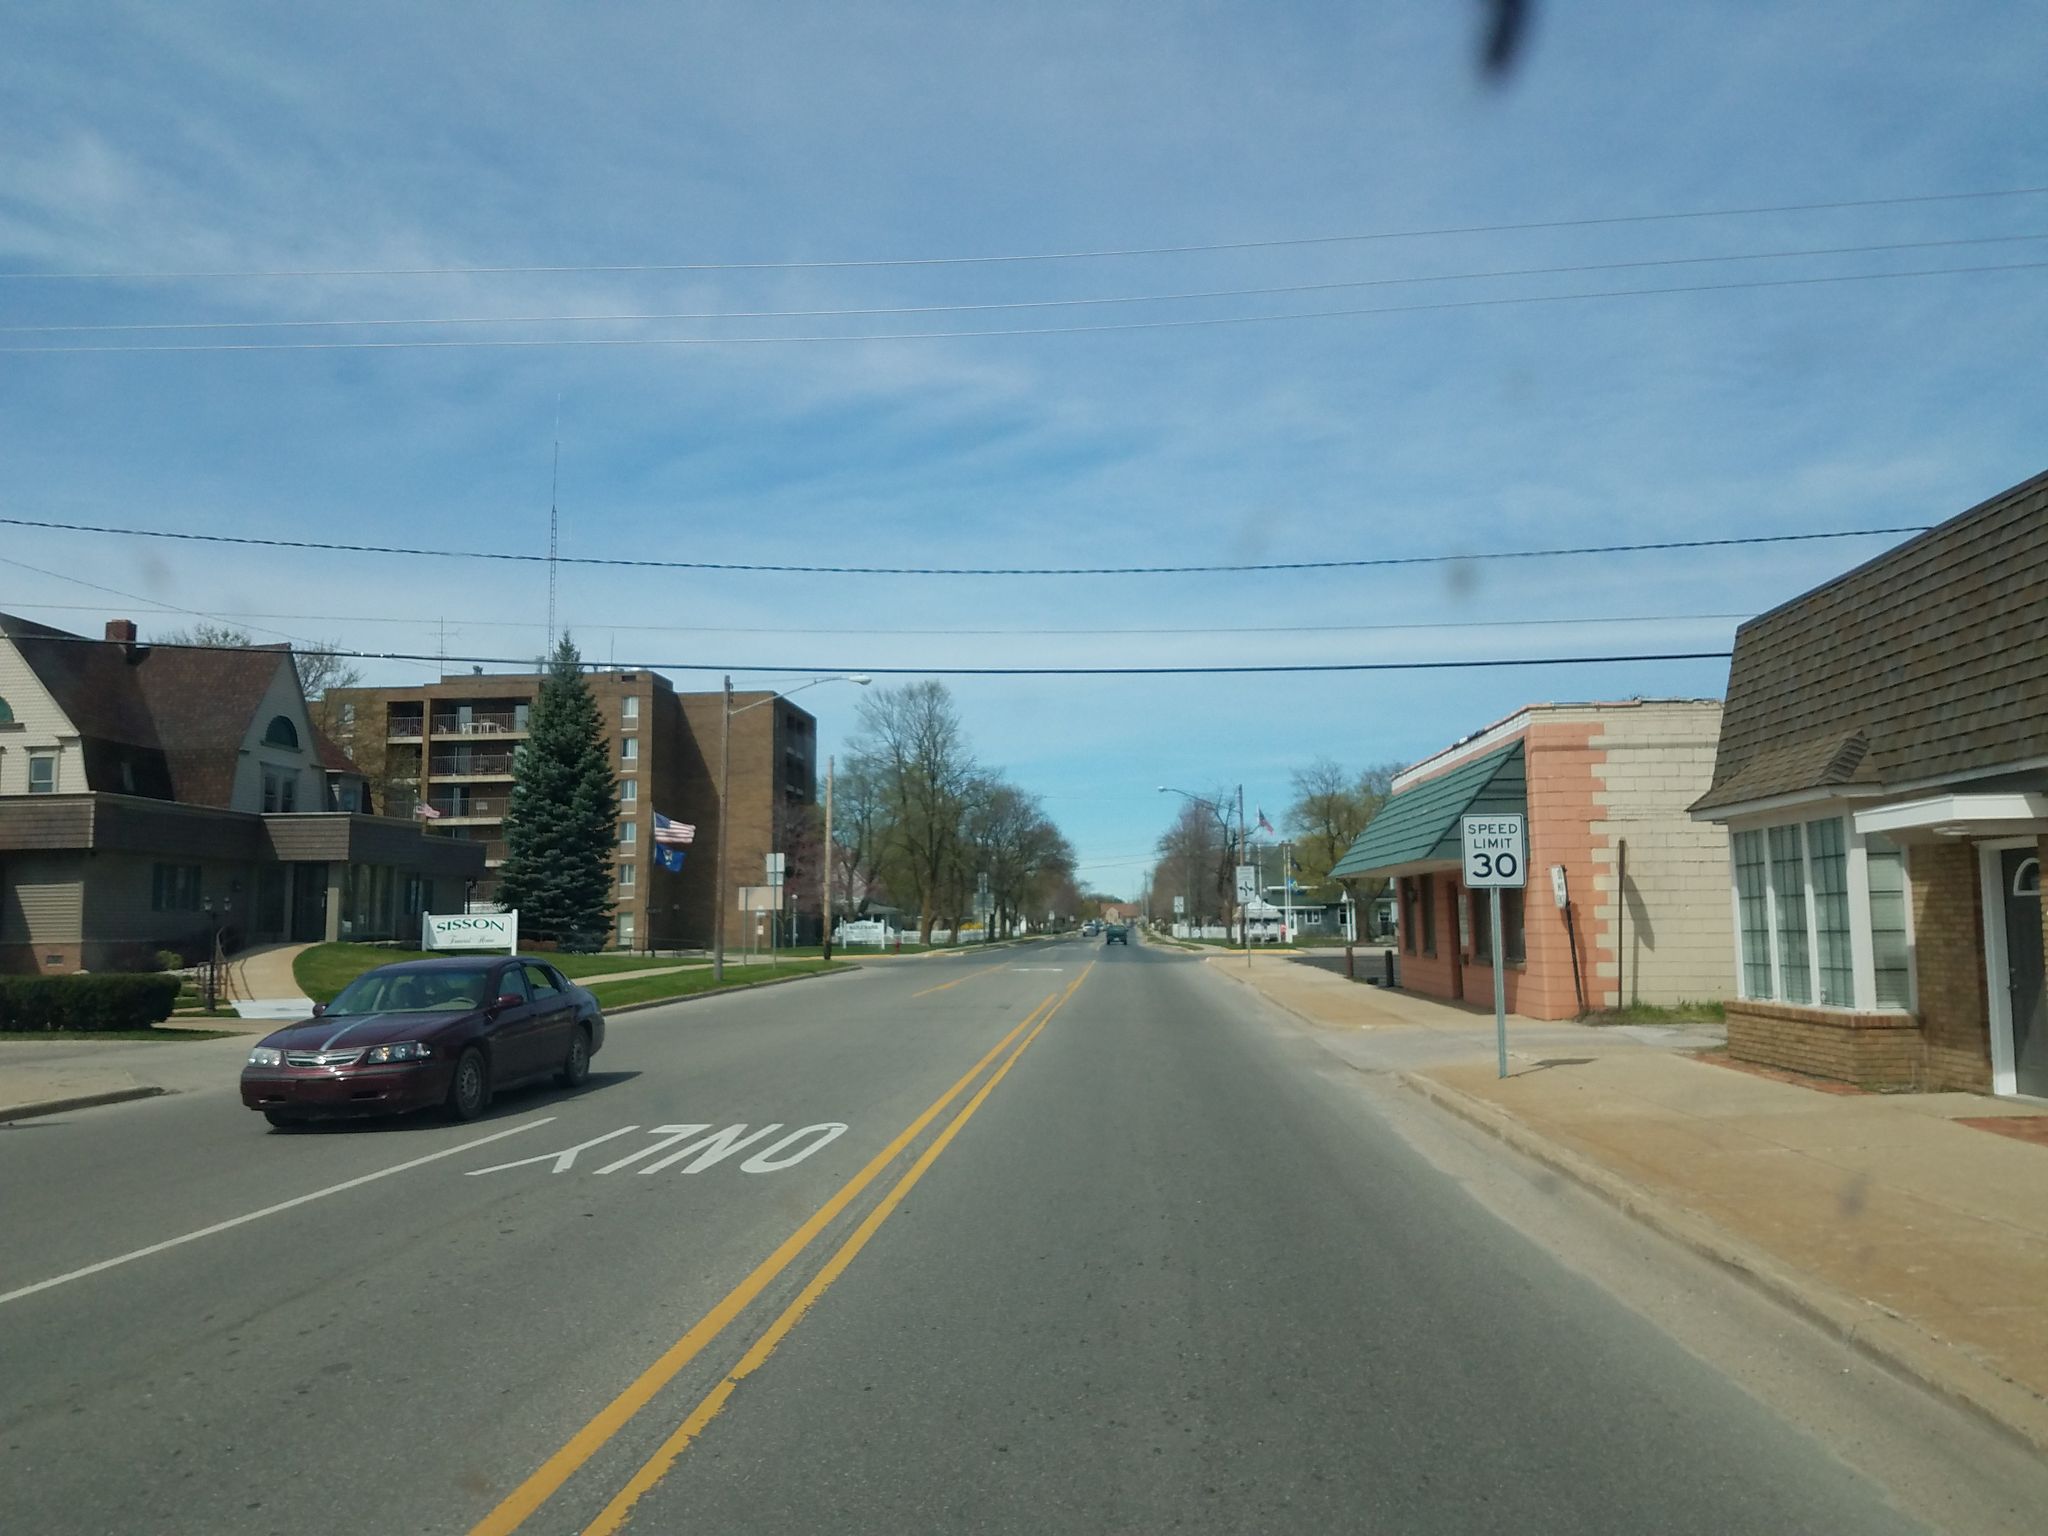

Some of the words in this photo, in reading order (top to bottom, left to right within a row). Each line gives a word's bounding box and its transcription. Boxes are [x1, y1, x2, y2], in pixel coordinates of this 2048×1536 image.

[1468, 823, 1518, 835] SPEED
[1473, 837, 1513, 849] LIMIT
[1472, 852, 1518, 878] 30
[436, 918, 505, 934] SISSON
[464, 1122, 849, 1176] ONLY
